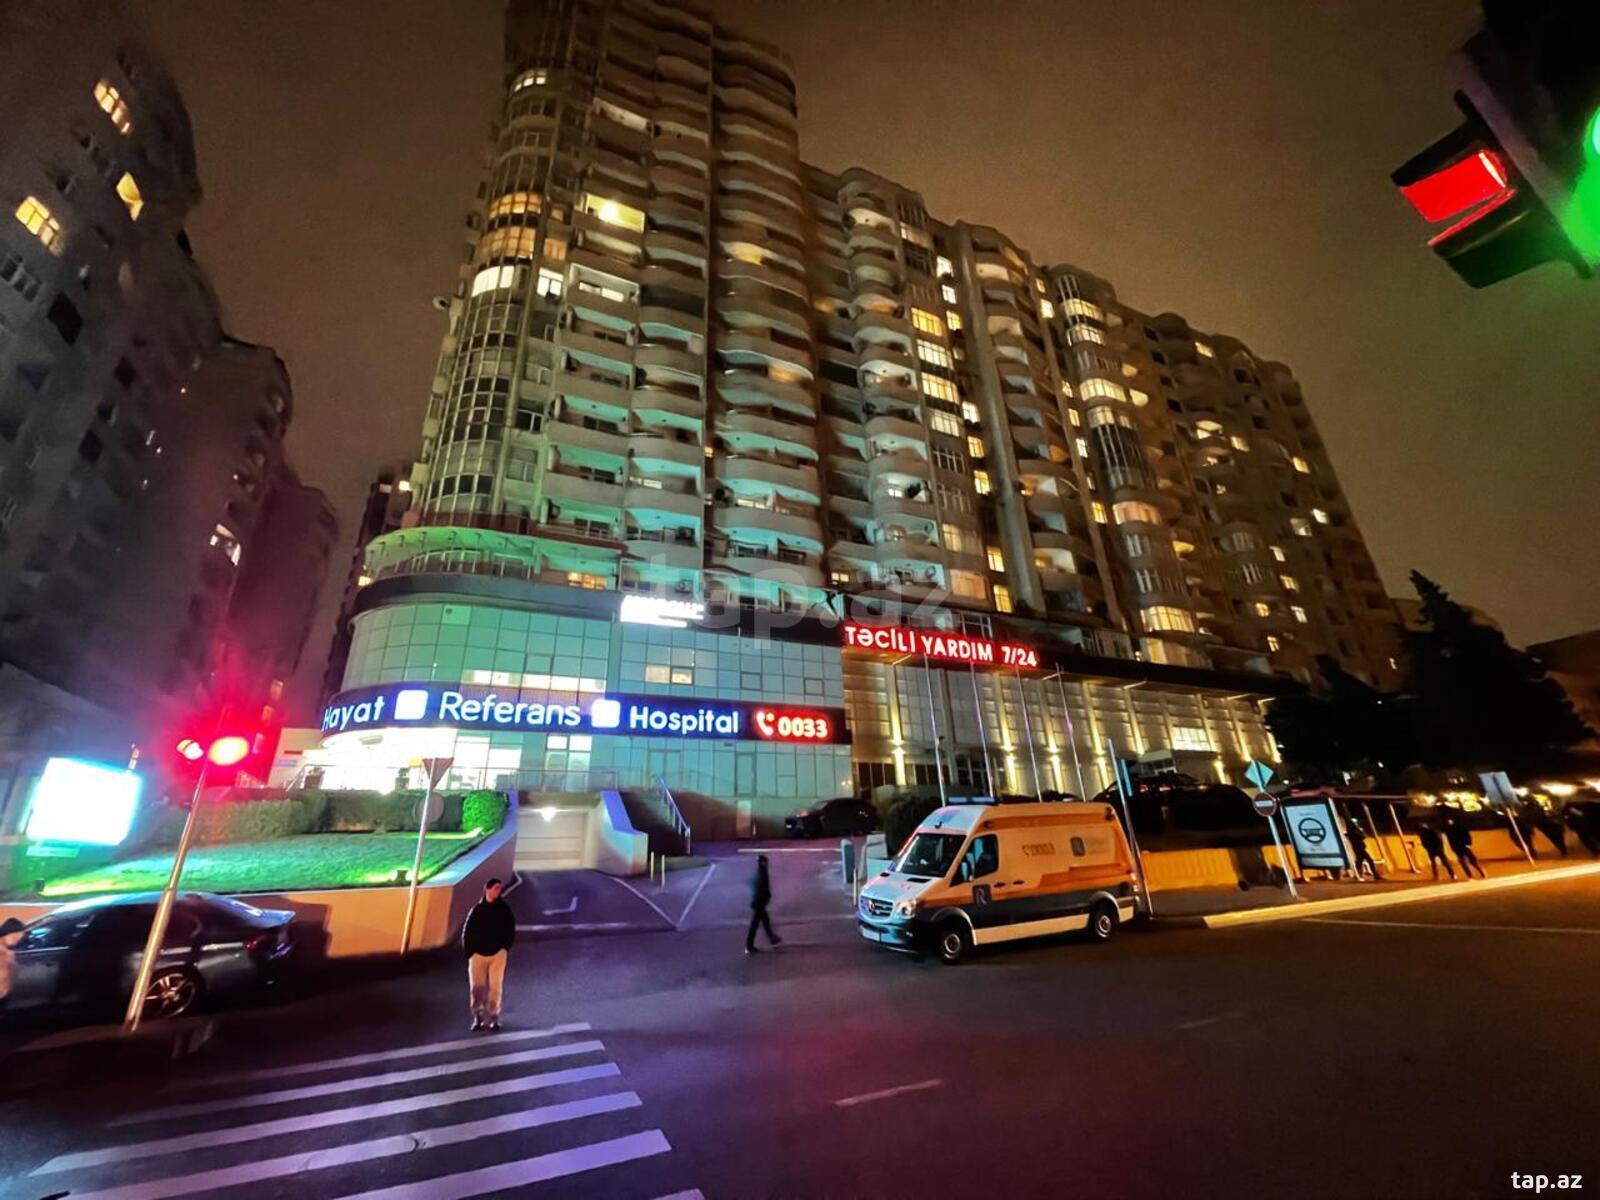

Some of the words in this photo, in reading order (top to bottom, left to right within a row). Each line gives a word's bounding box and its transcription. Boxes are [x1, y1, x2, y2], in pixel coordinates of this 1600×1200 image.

[921, 635, 993, 662] YARDIM
[1001, 645, 1037, 667] 7/24
[321, 695, 384, 732] Hayat
[438, 691, 581, 726] Referans
[629, 705, 739, 735] Hospital
[777, 717, 828, 738] 0033
